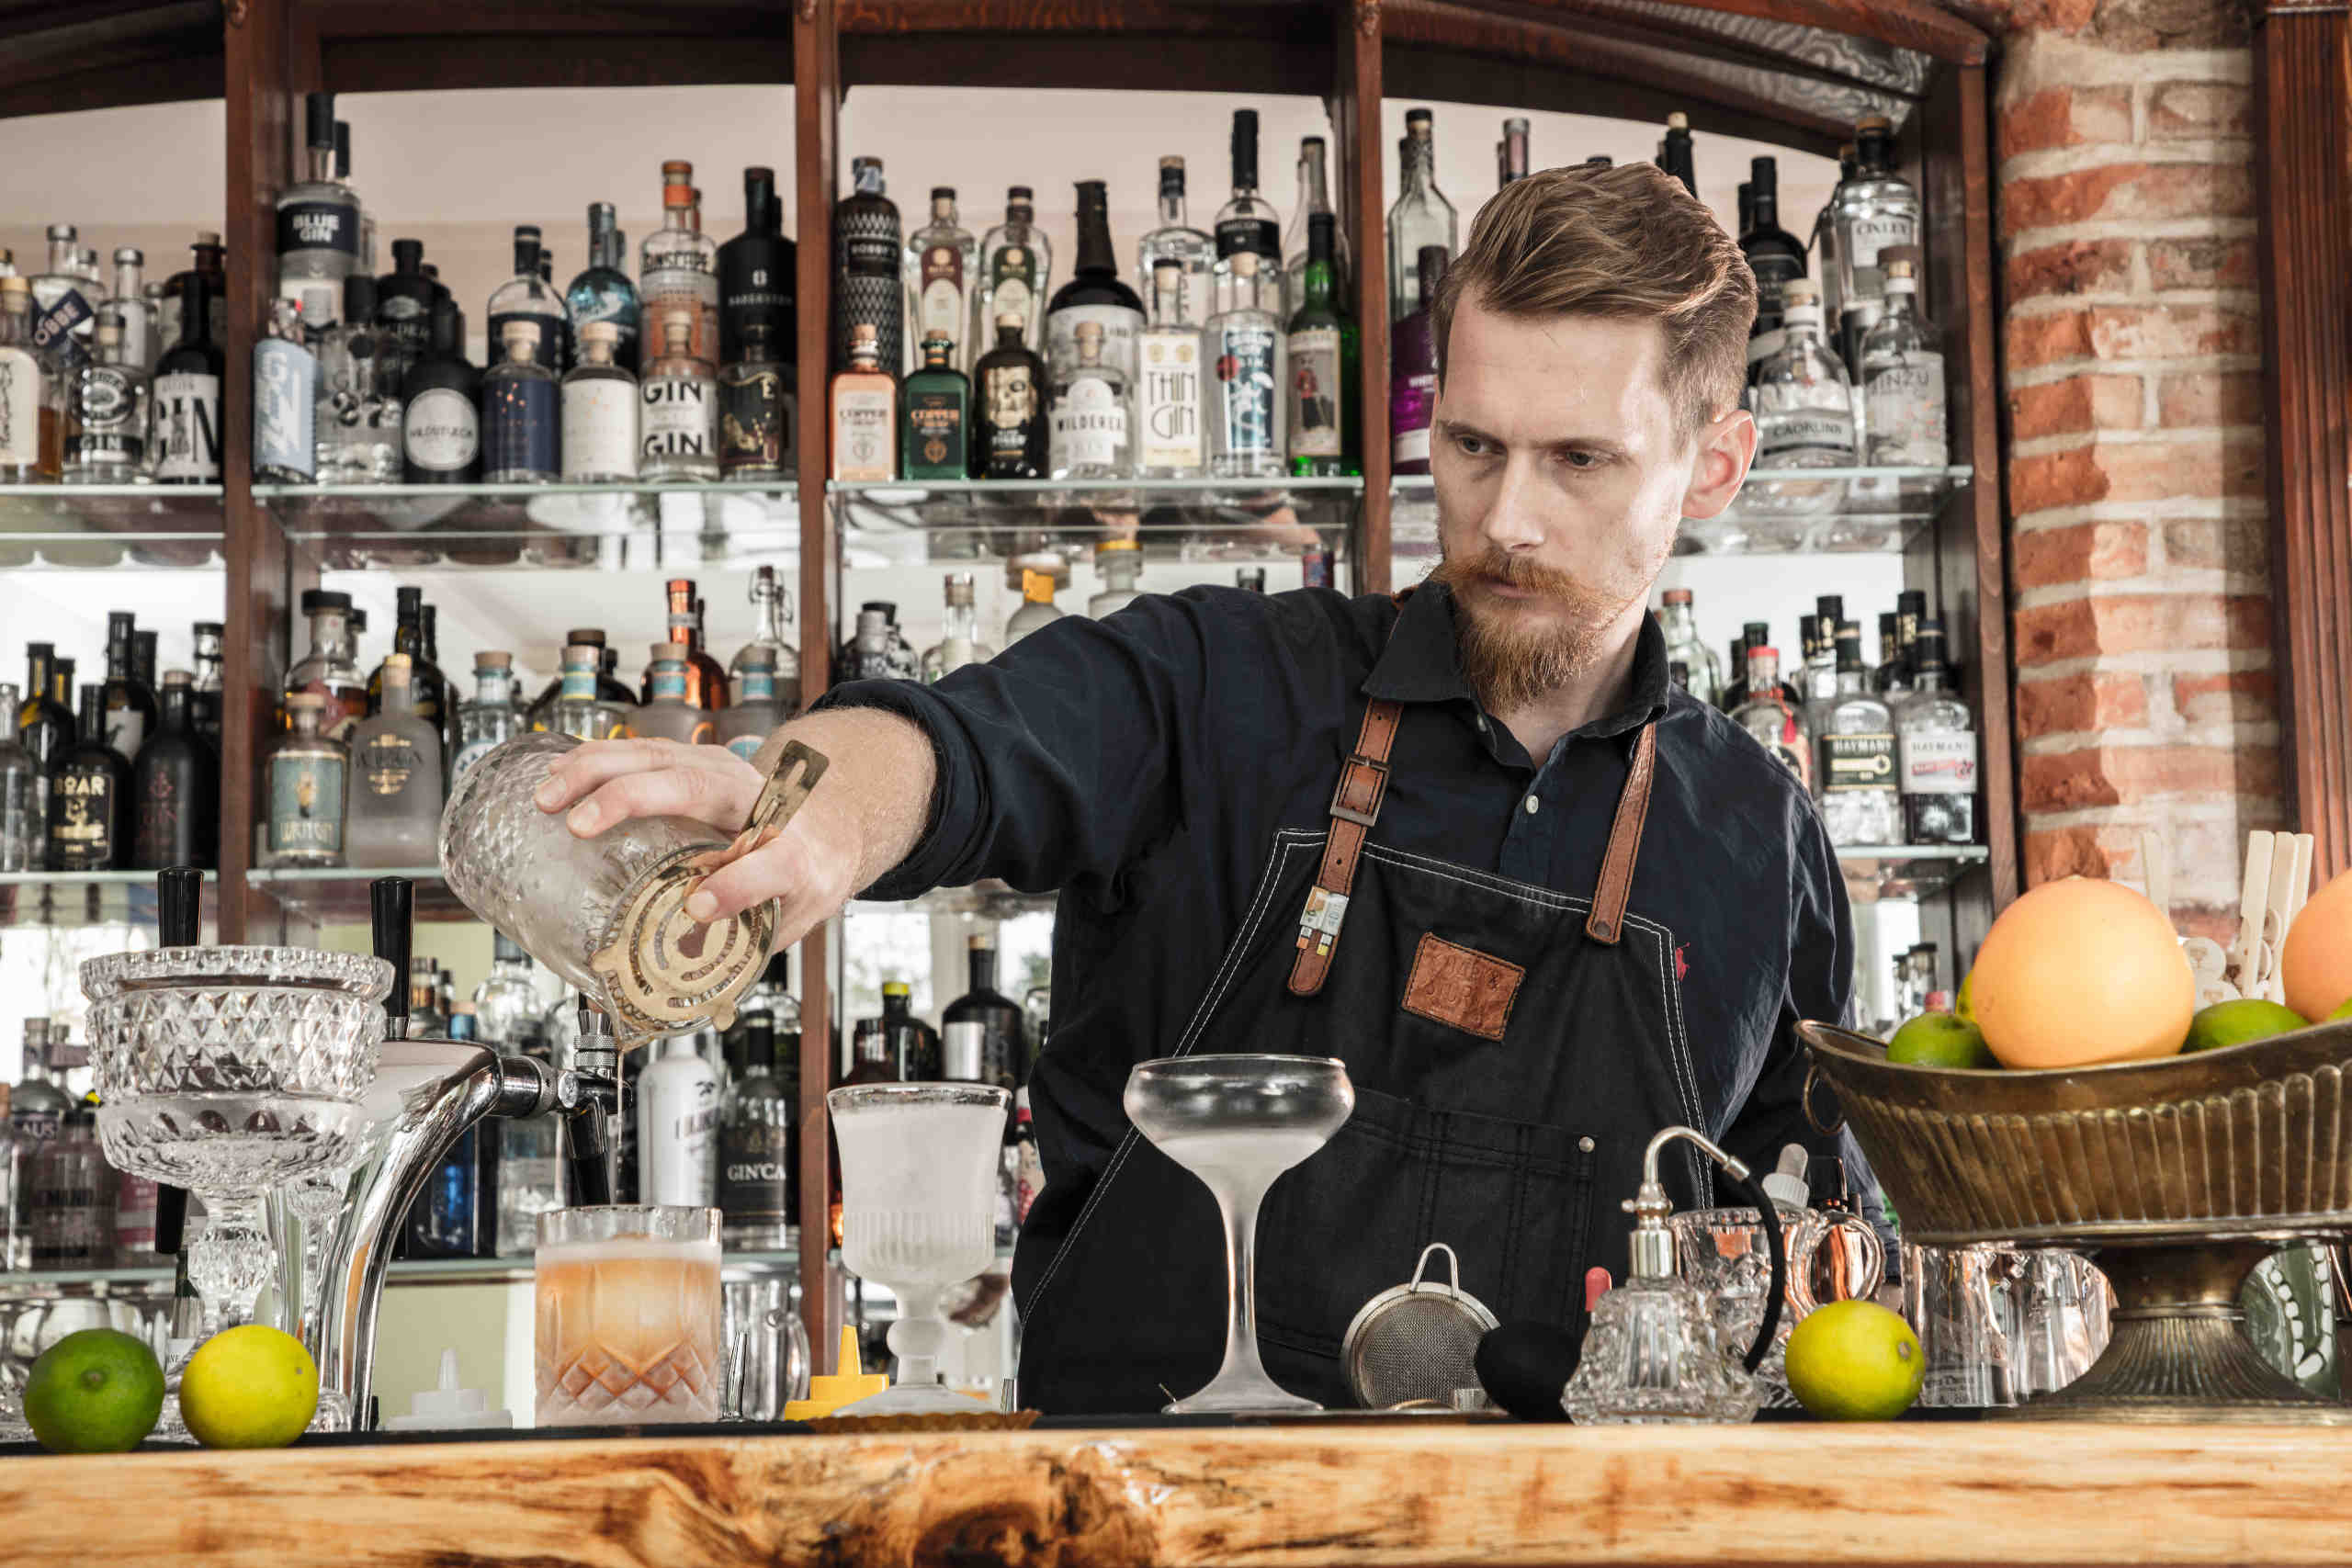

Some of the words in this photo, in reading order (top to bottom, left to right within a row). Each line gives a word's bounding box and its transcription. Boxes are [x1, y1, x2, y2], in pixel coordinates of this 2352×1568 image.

[293, 213, 339, 229] BLUE
[300, 227, 332, 242] GIN
[644, 380, 702, 404] GIN
[1148, 371, 1196, 405] THIN
[1151, 404, 1194, 439] GIN
[80, 434, 122, 450] GIN
[644, 432, 703, 457] GIN
